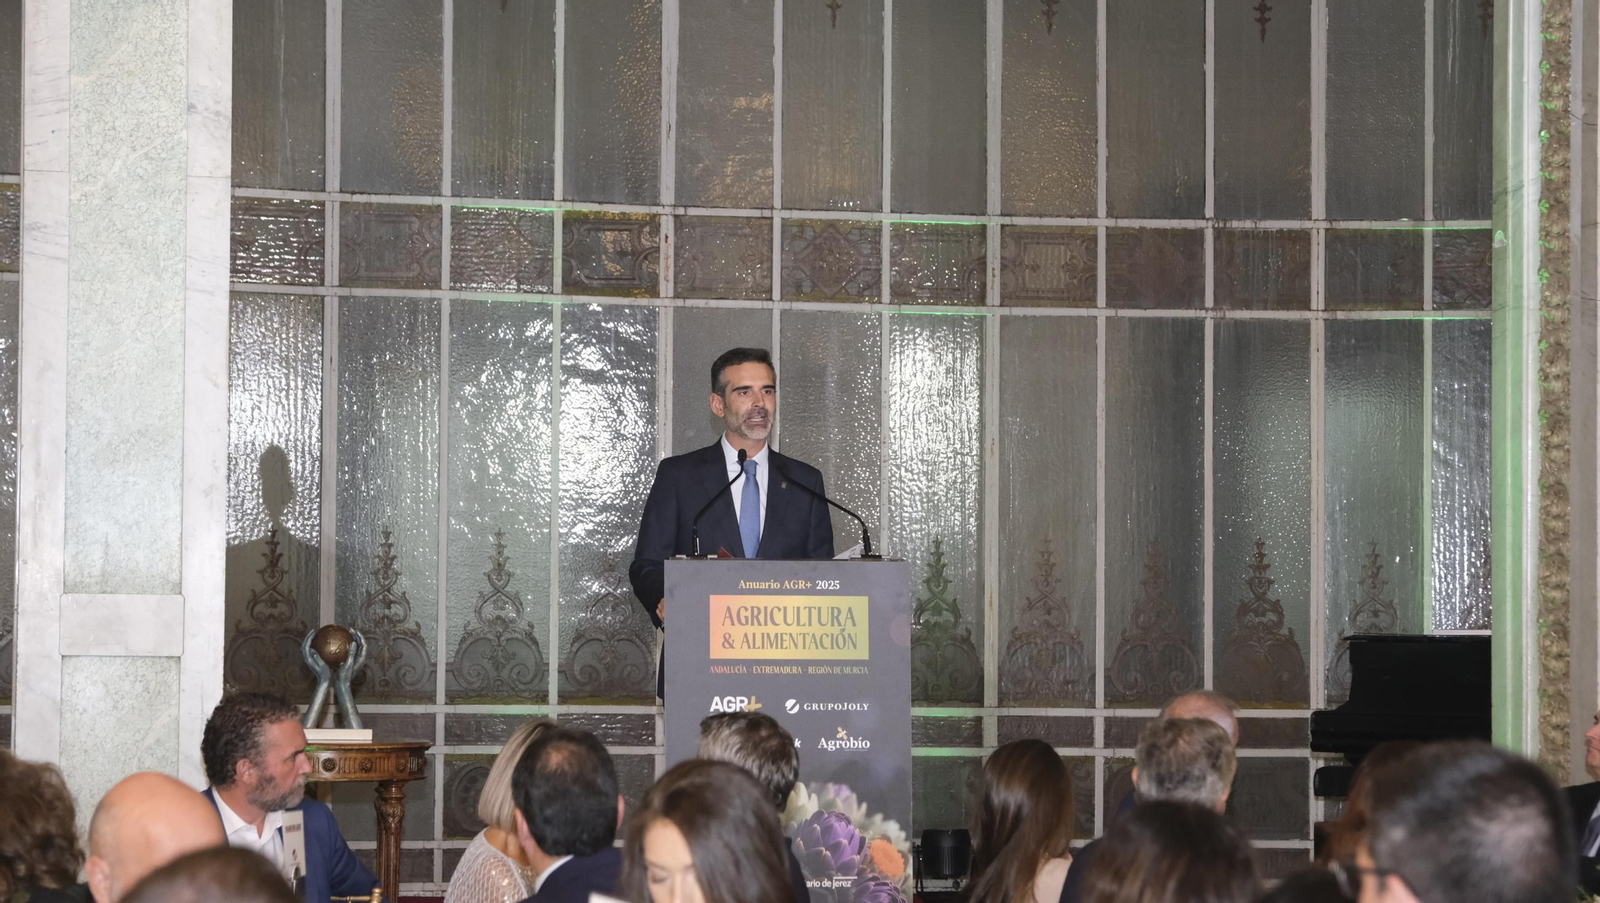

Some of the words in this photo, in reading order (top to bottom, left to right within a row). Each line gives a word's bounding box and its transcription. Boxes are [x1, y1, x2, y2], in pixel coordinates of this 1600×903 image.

[738, 579, 780, 589] Anuario
[783, 580, 813, 590] AGR+
[815, 580, 840, 590] 2025
[721, 605, 857, 627] AGRICULTURA
[721, 632, 735, 649] &
[740, 628, 858, 650] ALIMENTACIÓN
[709, 664, 747, 674] ANDALUCÍA
[752, 665, 802, 674] EXTREMADURA
[808, 664, 832, 675] REGIÓN
[833, 666, 842, 675] DE
[843, 666, 869, 675] MURCIA
[709, 695, 763, 713] AGR+
[817, 737, 871, 752] Agrobío
[821, 878, 831, 888] de
